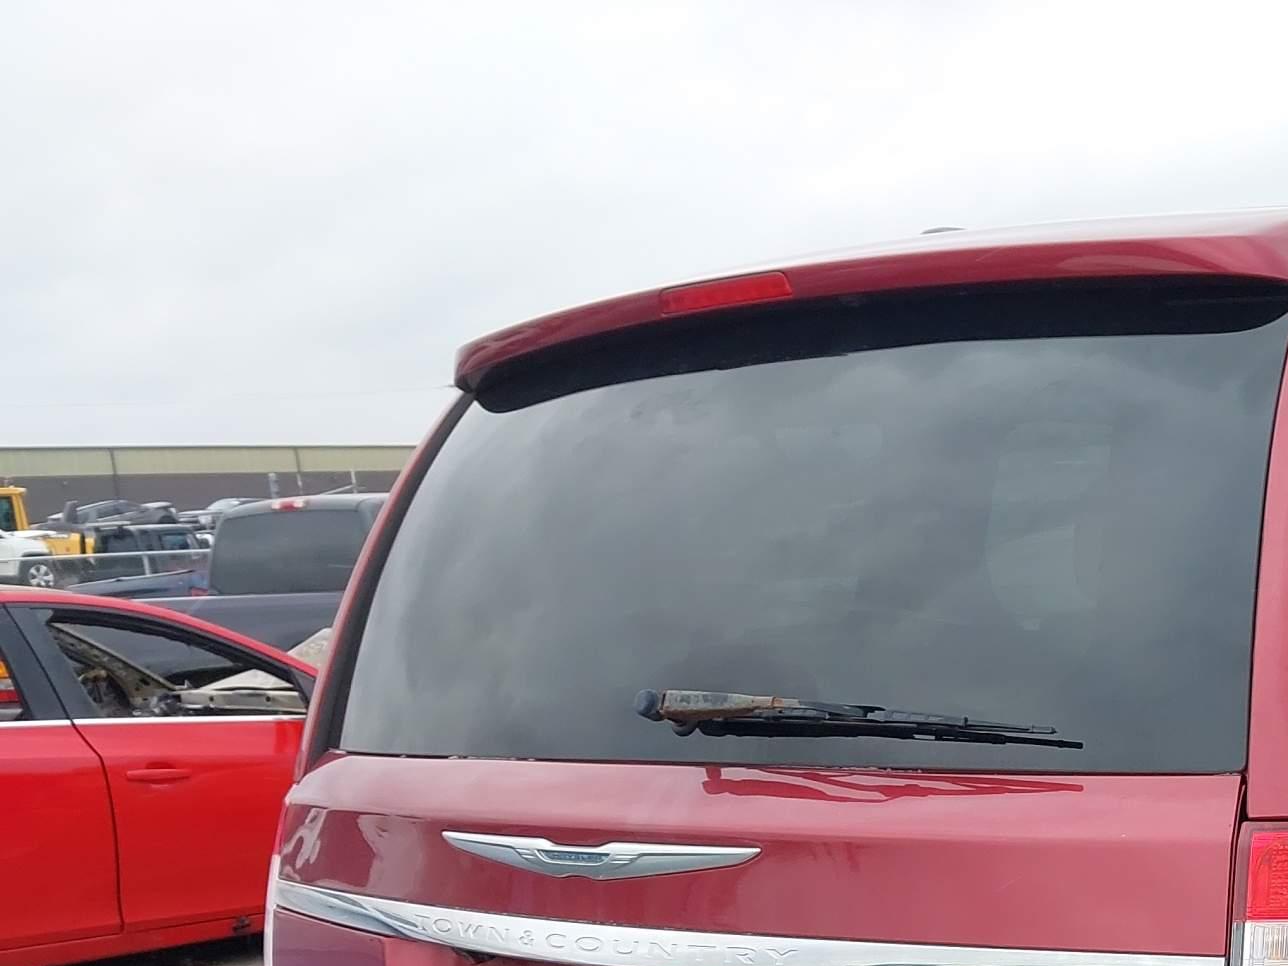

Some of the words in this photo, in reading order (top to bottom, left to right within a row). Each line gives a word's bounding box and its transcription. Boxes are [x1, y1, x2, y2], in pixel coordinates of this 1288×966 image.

[413, 913, 511, 944] TOWN
[518, 929, 537, 947] &
[544, 932, 799, 966] COUNTRY
